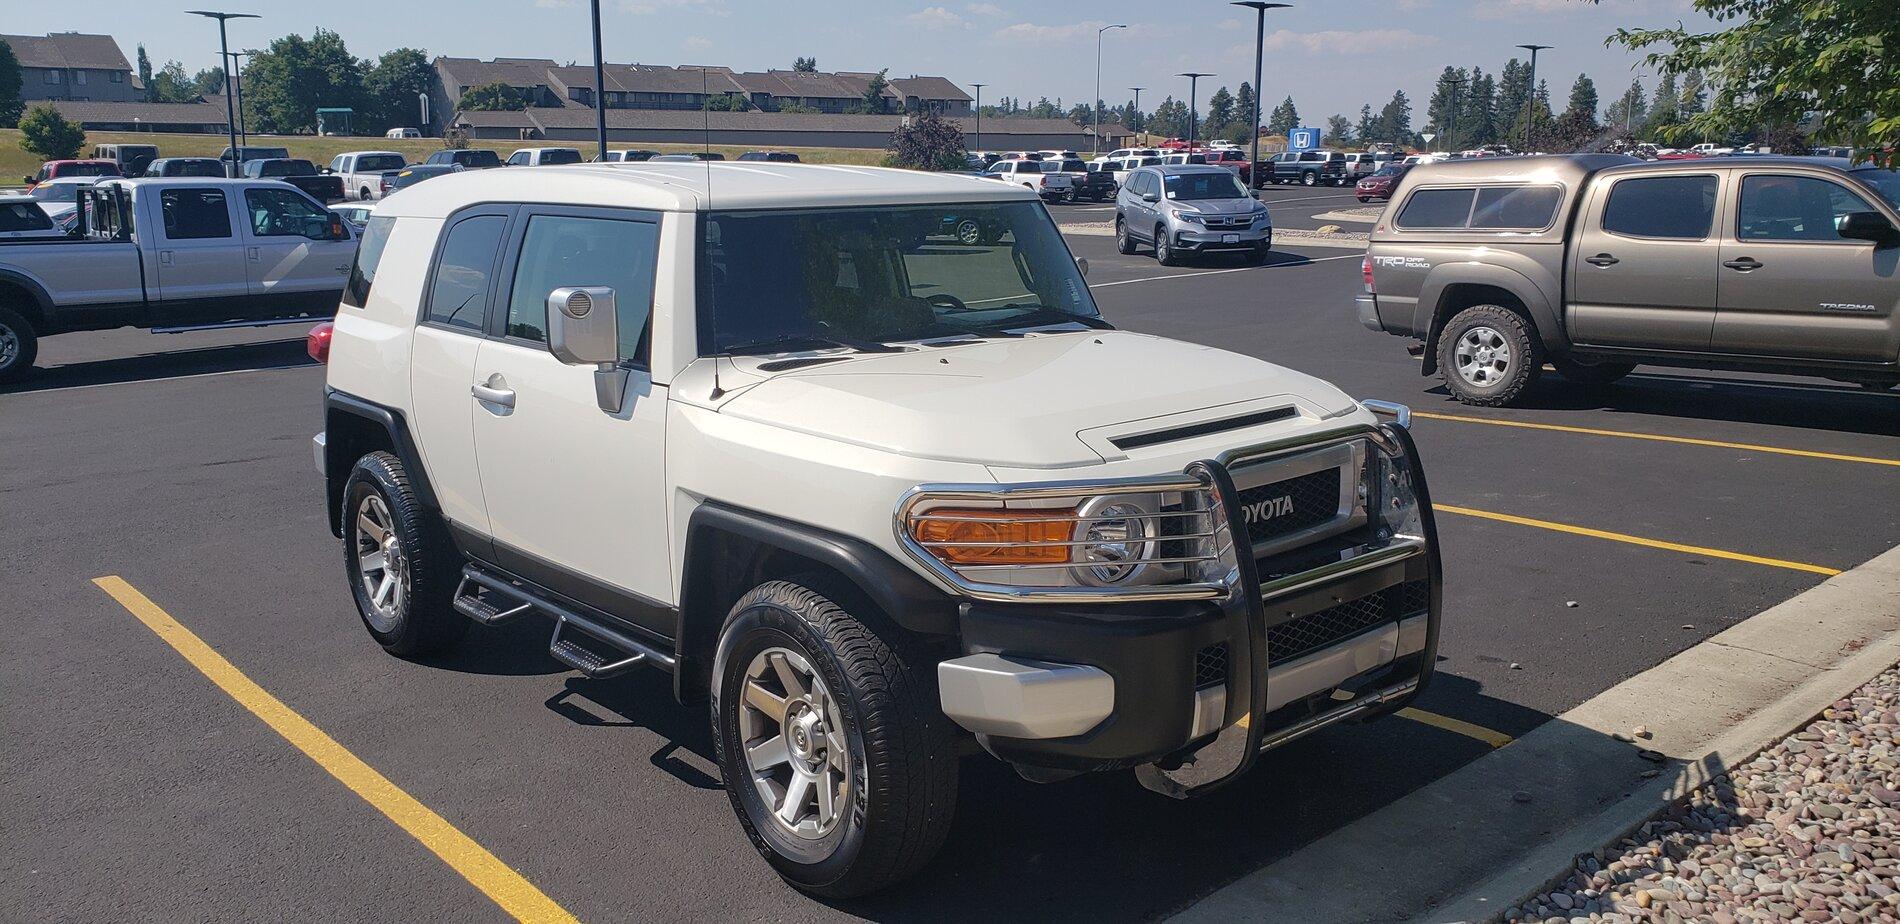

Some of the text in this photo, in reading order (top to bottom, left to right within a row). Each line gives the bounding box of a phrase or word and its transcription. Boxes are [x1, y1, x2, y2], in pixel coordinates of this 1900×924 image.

[1373, 256, 1405, 267] TRD
[1819, 302, 1876, 311] TACOMA
[1241, 495, 1294, 524] OYOTA
